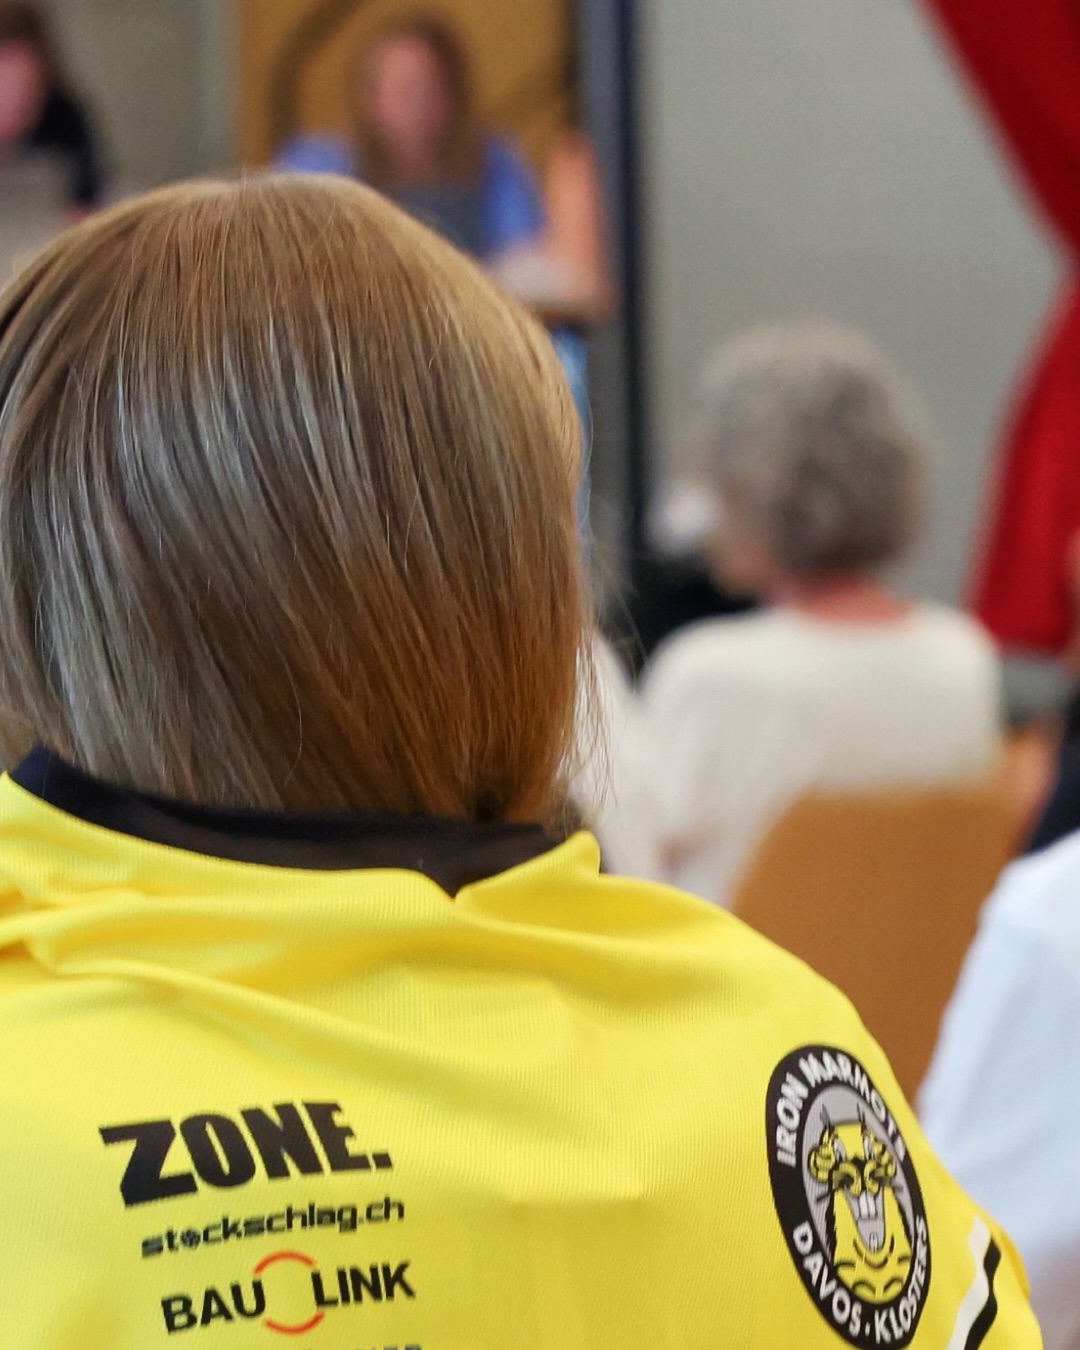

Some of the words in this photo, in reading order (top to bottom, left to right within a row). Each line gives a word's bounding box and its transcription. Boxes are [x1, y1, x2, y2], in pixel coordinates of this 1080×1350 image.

[98, 1101, 393, 1208] ZONE.
[776, 1071, 809, 1168] IRON
[141, 1194, 405, 1259] stockschlag.ch
[160, 1278, 267, 1336] BAU
[311, 1260, 416, 1310] LINK
